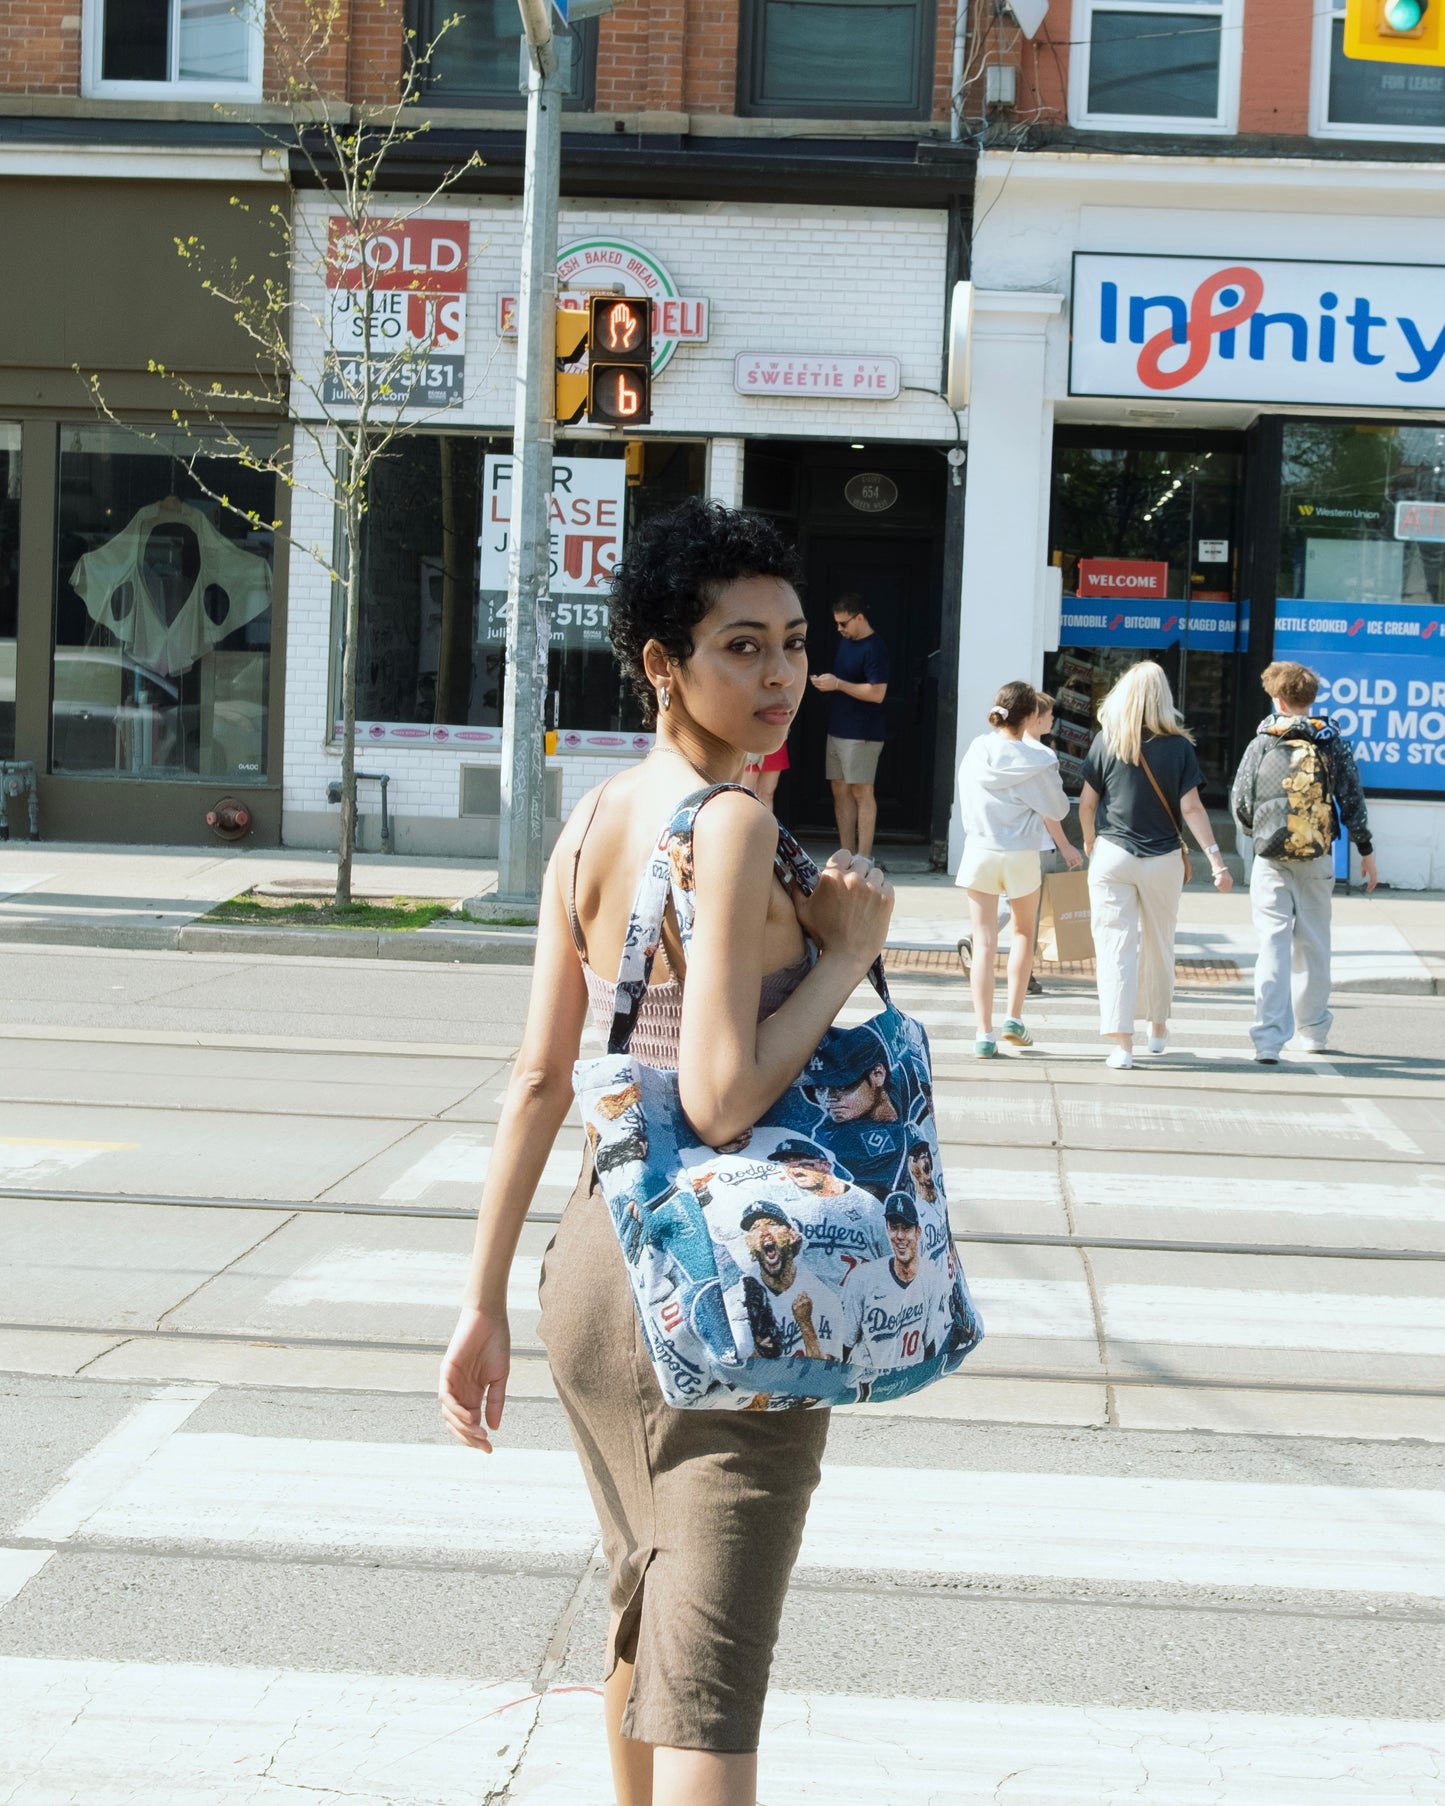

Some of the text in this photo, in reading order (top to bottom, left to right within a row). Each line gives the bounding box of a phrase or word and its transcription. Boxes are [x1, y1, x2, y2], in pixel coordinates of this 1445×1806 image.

[1408, 76, 1443, 91] LEASE
[335, 235, 462, 272] SOLD
[584, 251, 623, 266] BAKED
[626, 257, 658, 289] BREAD
[351, 316, 402, 338] SEO
[1100, 266, 1445, 391] Infinity
[754, 361, 880, 373] SWEETS BY
[747, 370, 887, 388] SWEETIE PIE
[492, 463, 573, 494] FR
[491, 495, 618, 527] LASE
[1315, 507, 1380, 519] Western Union
[1087, 574, 1158, 589] WELCOME
[1124, 616, 1161, 630] BITCOIN
[1275, 617, 1307, 632] KETTLE
[1308, 618, 1348, 633] COOKED
[1367, 620, 1383, 635] ICE
[1384, 621, 1420, 636] CREAM
[1387, 710, 1445, 741] MO
[900, 1329, 920, 1358] 10
